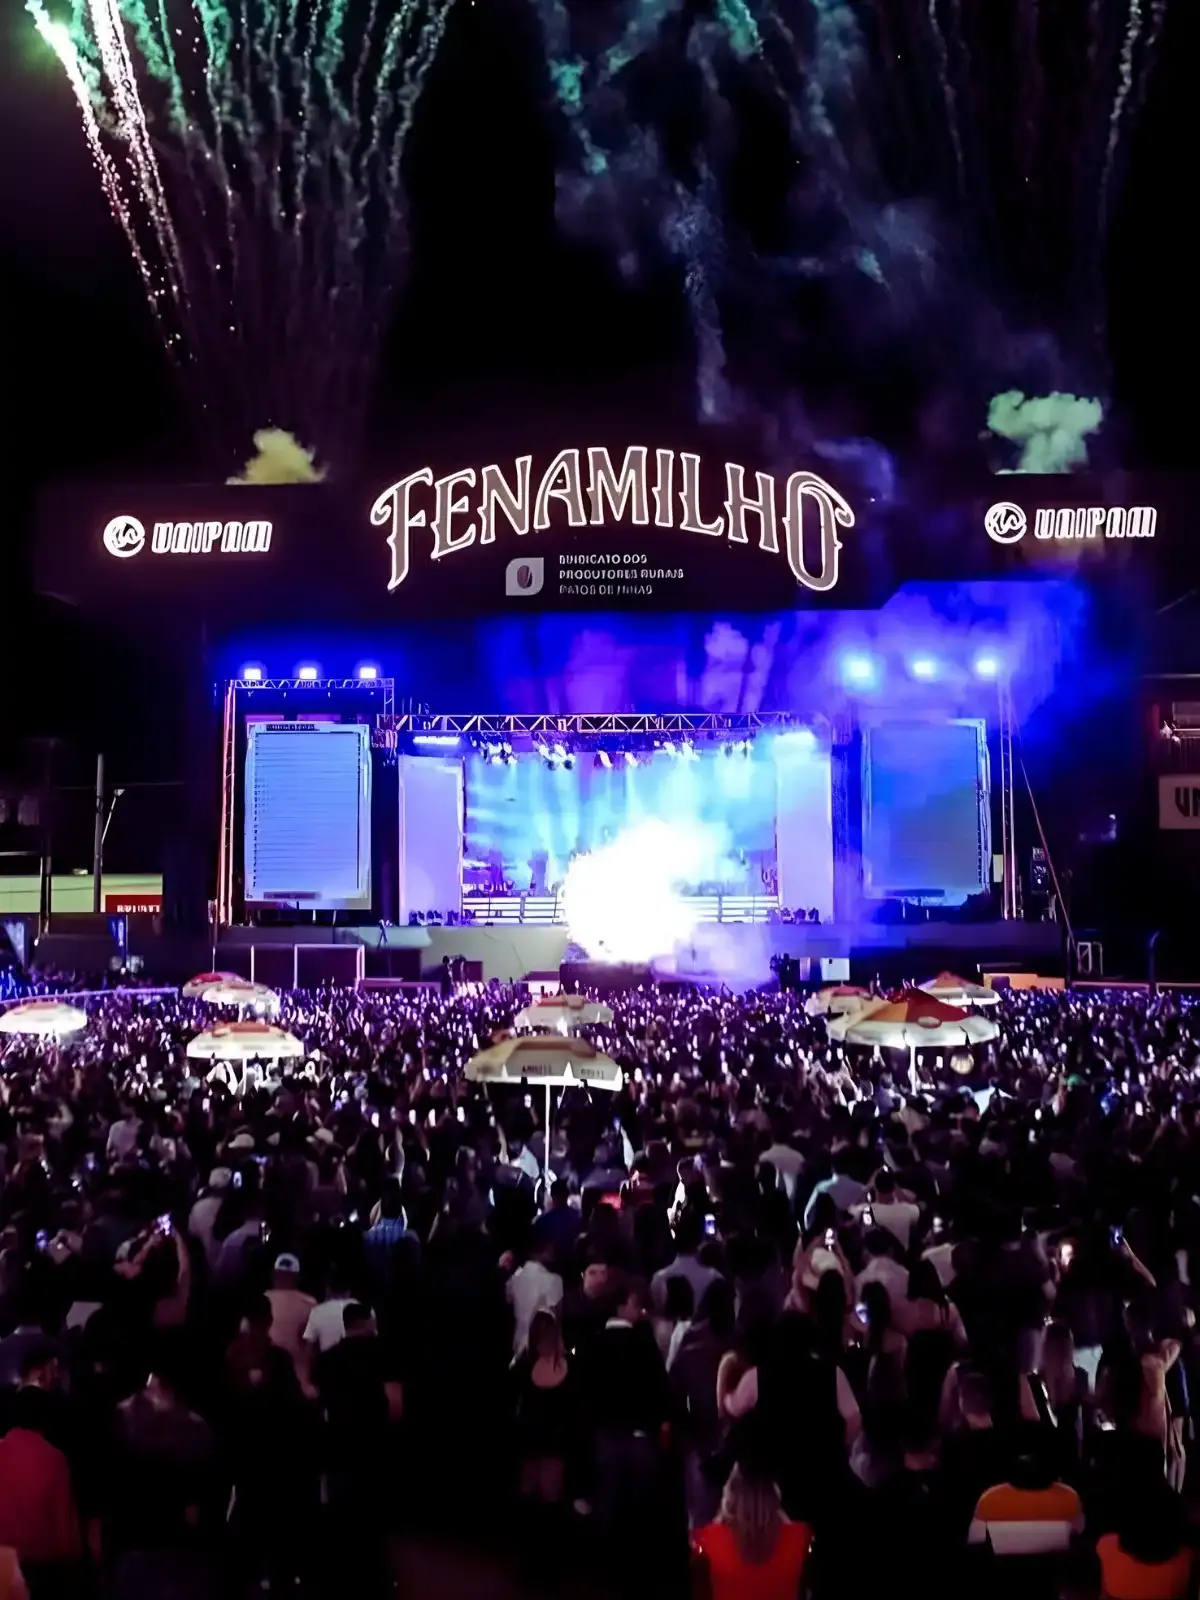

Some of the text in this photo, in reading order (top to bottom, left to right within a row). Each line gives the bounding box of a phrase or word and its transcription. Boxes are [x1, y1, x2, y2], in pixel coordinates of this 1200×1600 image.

[370, 446, 855, 591] FENAMILHO
[1034, 506, 1158, 539] UNIPAM
[151, 520, 273, 554] UNIPAM
